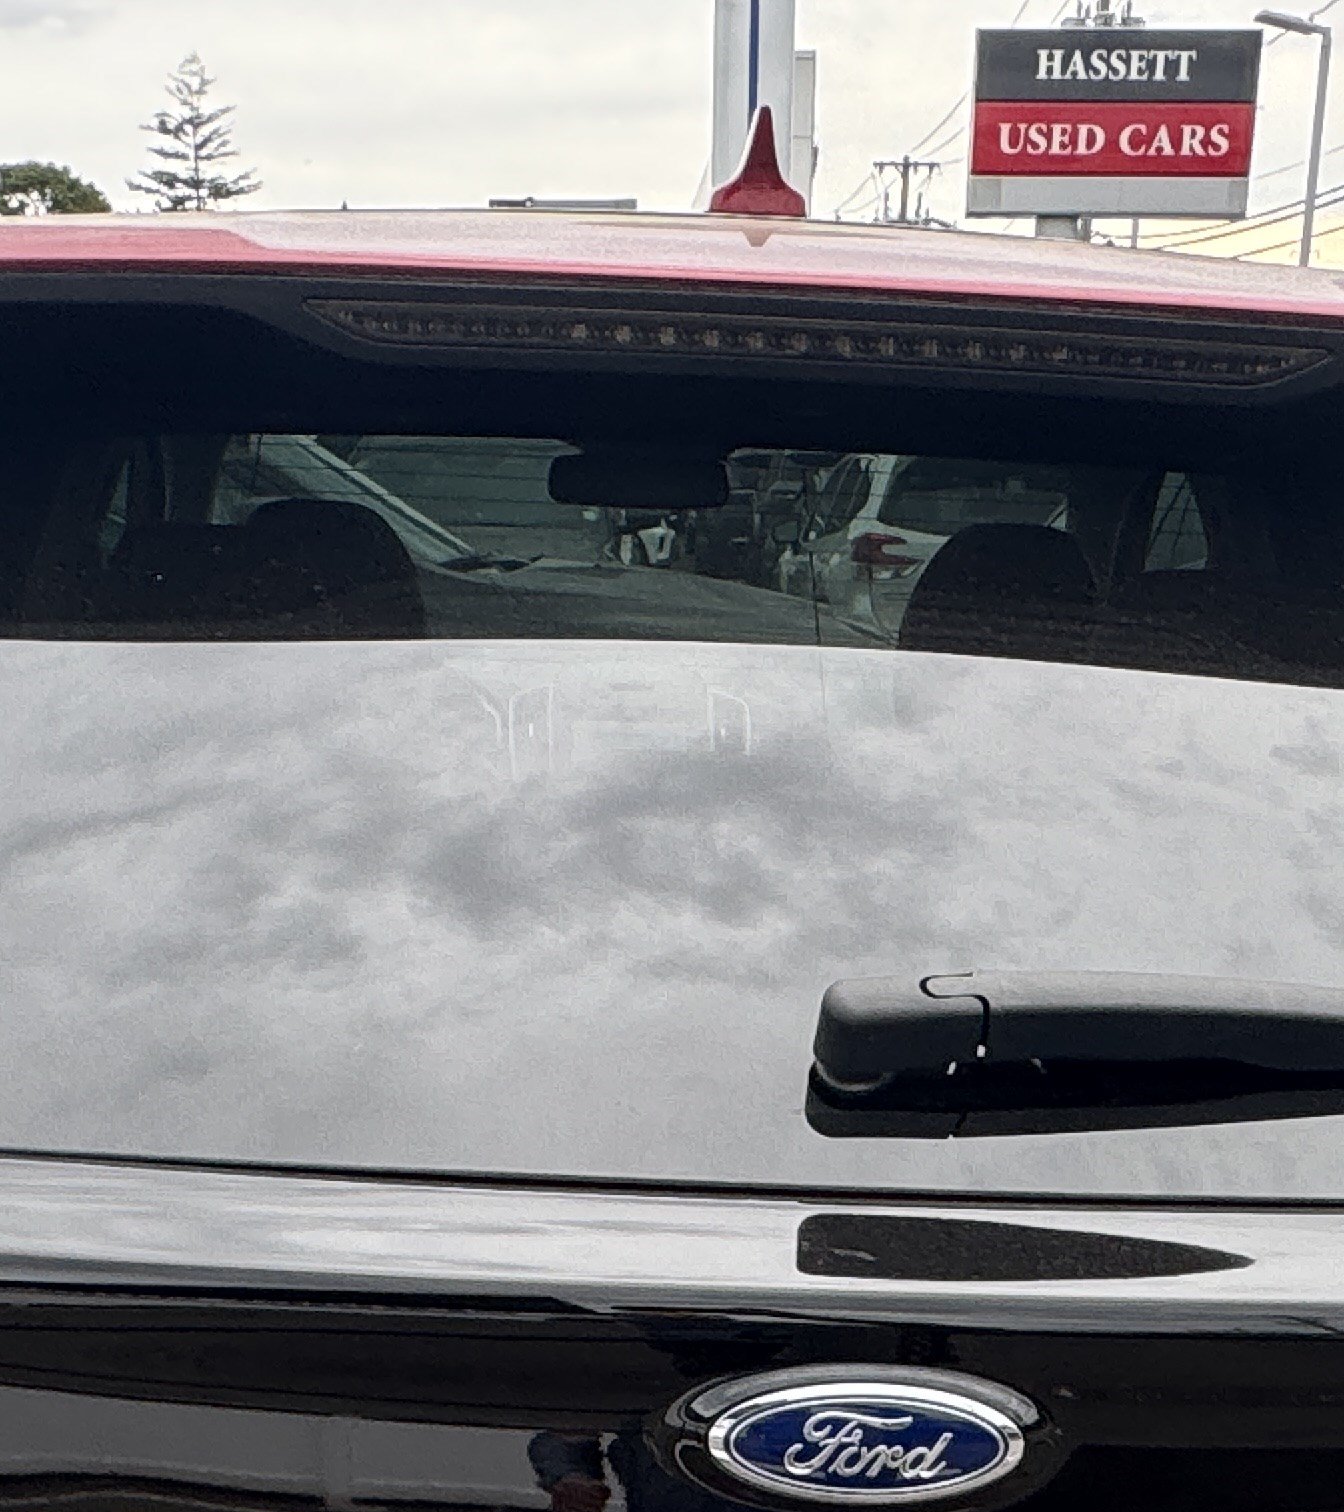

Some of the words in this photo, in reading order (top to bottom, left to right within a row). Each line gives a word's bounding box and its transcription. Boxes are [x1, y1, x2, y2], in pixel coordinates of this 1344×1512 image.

[1035, 49, 1197, 82] HASSETT
[998, 122, 1106, 155] USED
[1119, 123, 1230, 157] CARS
[783, 1410, 954, 1479] Ford
